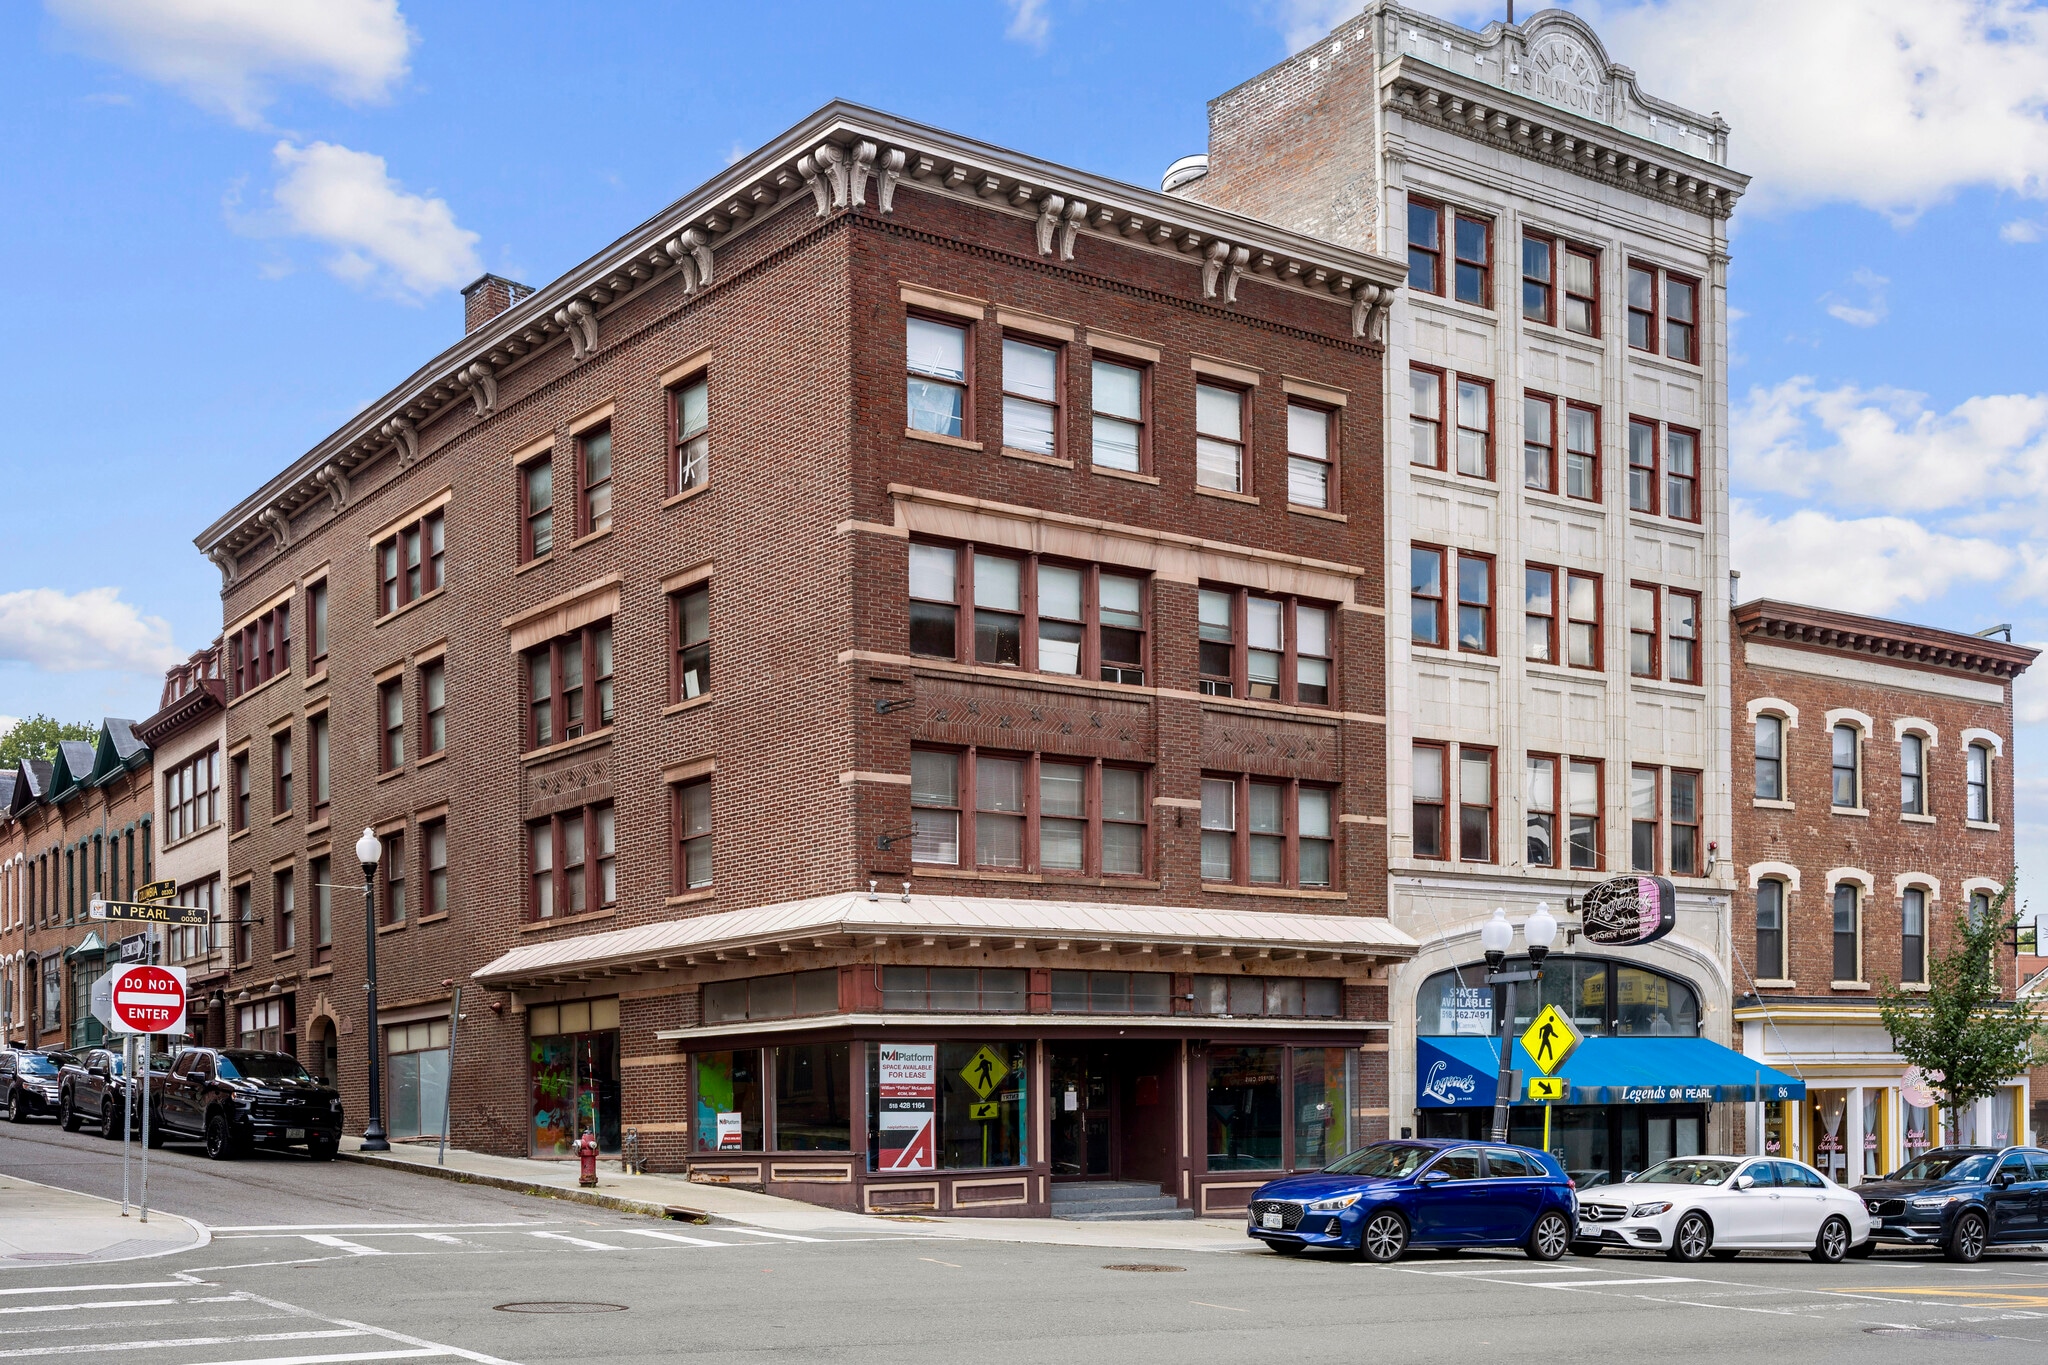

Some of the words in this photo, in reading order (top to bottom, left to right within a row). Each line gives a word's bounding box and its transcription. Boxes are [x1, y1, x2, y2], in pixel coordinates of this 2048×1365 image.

[1535, 43, 1595, 87] HARRY
[1522, 70, 1604, 115] SIMMONS
[112, 905, 121, 916] N
[130, 906, 170, 920] PEARL
[1584, 881, 1652, 930] Legends
[124, 978, 142, 989] DO
[148, 980, 174, 991] NOT
[1450, 988, 1478, 998] SPACE
[1441, 997, 1491, 1008] AVAILABLE
[128, 1007, 169, 1020] ENTER
[1423, 1060, 1475, 1104] Legends
[1621, 1085, 1665, 1102] Legends
[1669, 1089, 1682, 1099] ON
[1685, 1089, 1712, 1099] PEARL
[1778, 1087, 1788, 1098] 86
